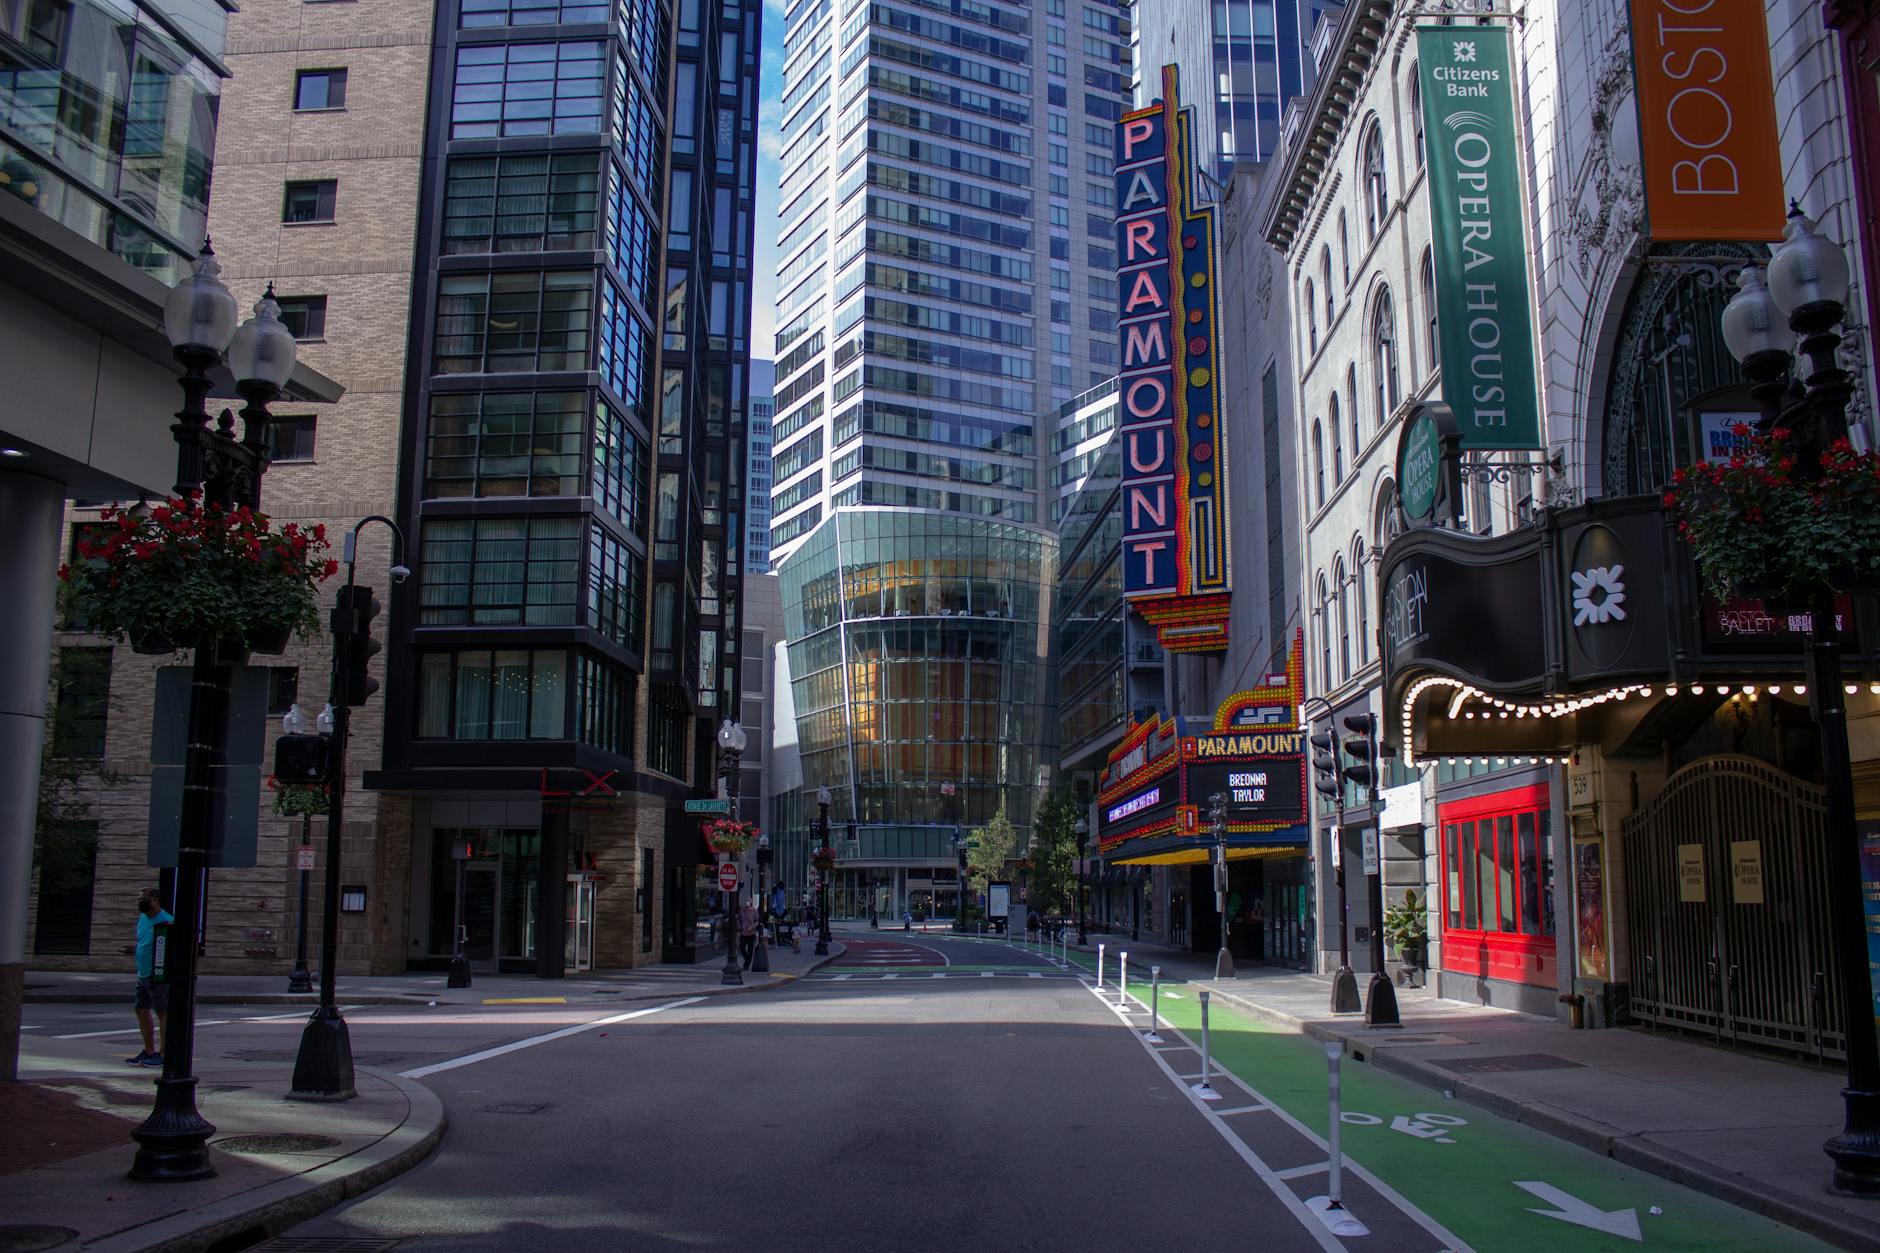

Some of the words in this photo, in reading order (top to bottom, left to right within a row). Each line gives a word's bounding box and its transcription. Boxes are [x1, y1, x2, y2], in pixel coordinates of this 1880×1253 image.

[1432, 66, 1500, 82] Citizens
[1446, 83, 1489, 98] Bank
[1657, 0, 1740, 195] BOST
[1453, 132, 1495, 273] OPERA
[1123, 118, 1168, 585] PARAMOUNT
[1464, 282, 1508, 429] HOUSE
[1406, 446, 1435, 487] OPERA
[1411, 471, 1433, 505] HOUSE
[1198, 733, 1304, 756] PARAMOUNT
[540, 766, 621, 797] LX
[1229, 773, 1268, 787] BREONNA
[1574, 776, 1587, 795] 539
[1233, 788, 1266, 803] TAYLOR
[1683, 866, 1703, 876] OPERA
[1738, 864, 1760, 875] OPERA
